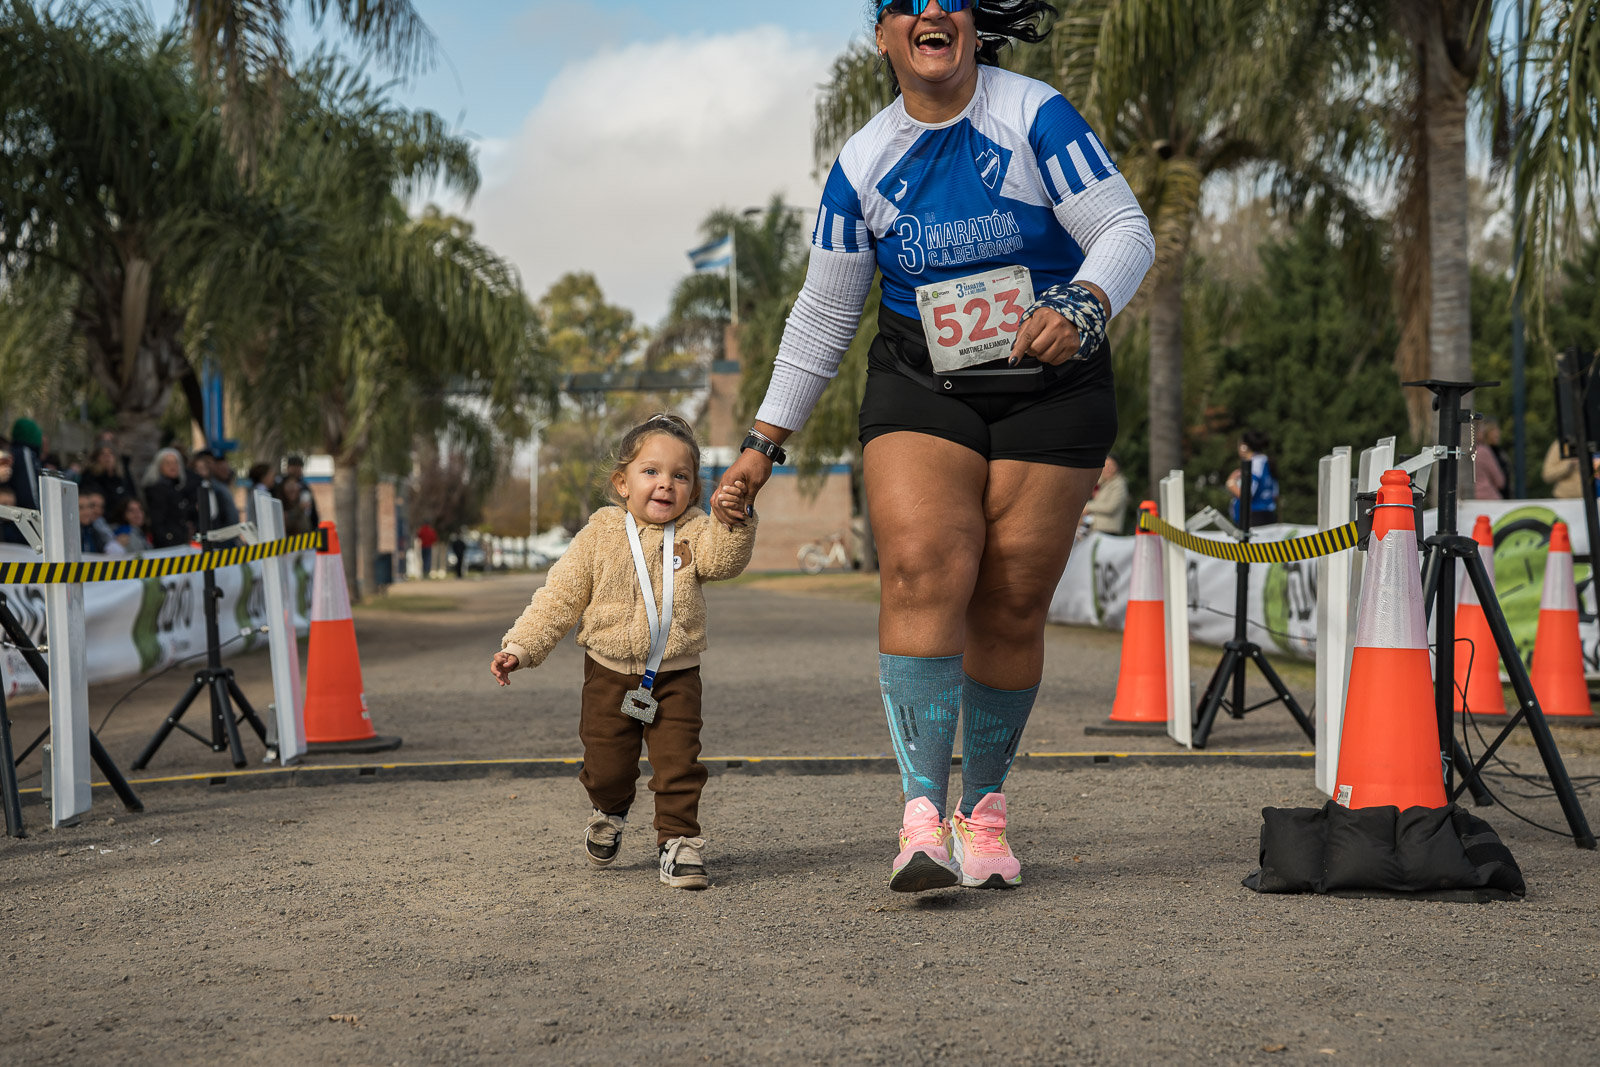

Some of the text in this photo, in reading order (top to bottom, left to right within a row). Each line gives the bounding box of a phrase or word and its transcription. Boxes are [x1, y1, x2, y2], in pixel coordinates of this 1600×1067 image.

[892, 214, 925, 275] 3
[925, 209, 1020, 250] MARATÓN
[955, 283, 965, 298] 3
[933, 288, 1026, 347] 523
[983, 338, 1011, 350] ALEJANDRA
